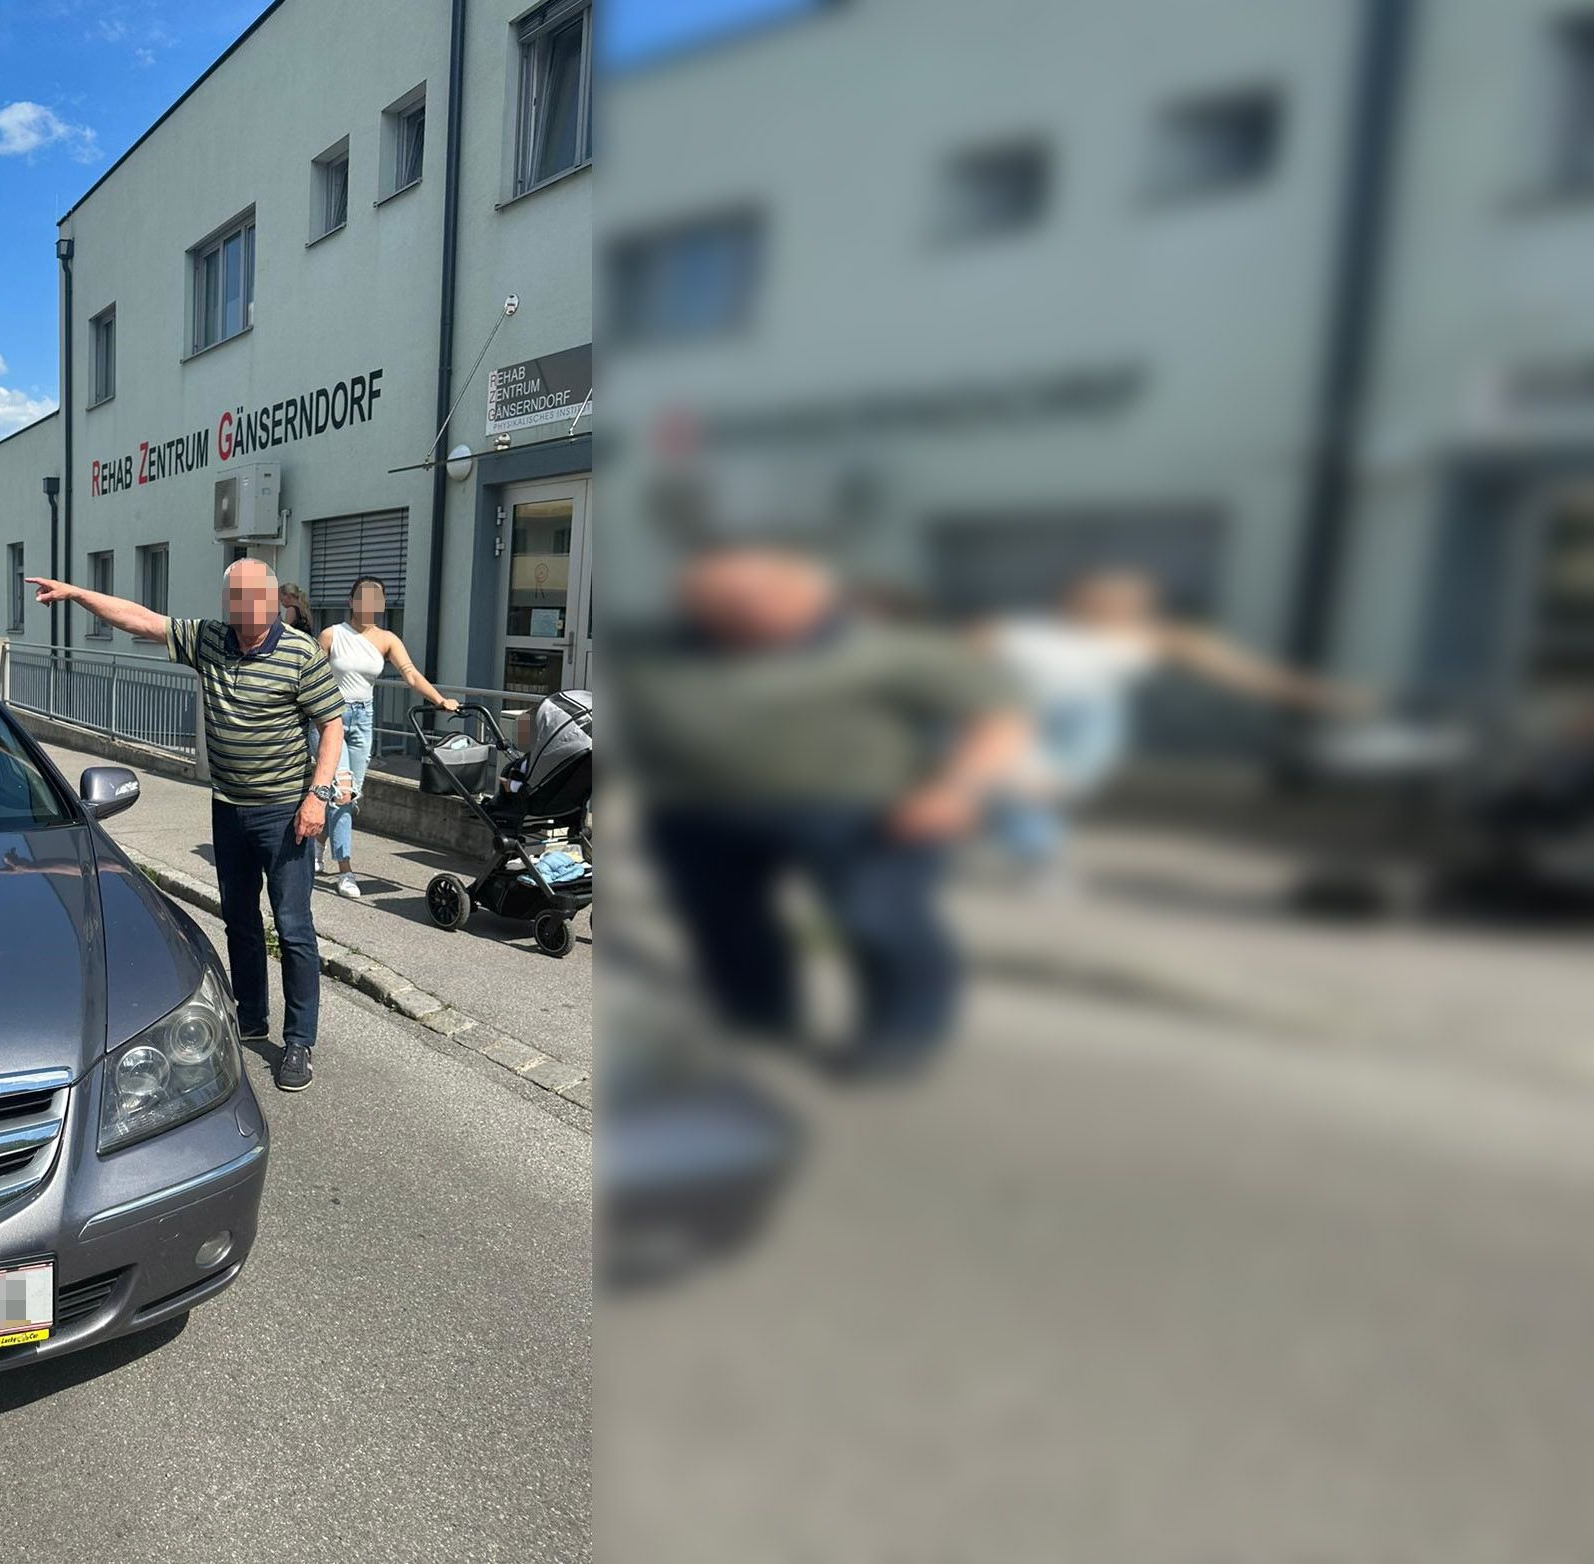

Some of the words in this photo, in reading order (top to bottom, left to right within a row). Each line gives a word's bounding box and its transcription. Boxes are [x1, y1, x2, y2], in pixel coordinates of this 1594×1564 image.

[489, 366, 526, 388] REHAB
[489, 378, 541, 404] ZENTRUM
[487, 390, 572, 422] GÄNSERNDORF
[493, 411, 554, 430] PHYSIKALISCHES
[91, 449, 133, 498] REHAB
[138, 428, 210, 485] ZENTRUM
[217, 368, 384, 461] GÄNSERNDORF
[0, 1336, 17, 1345] Lucky
